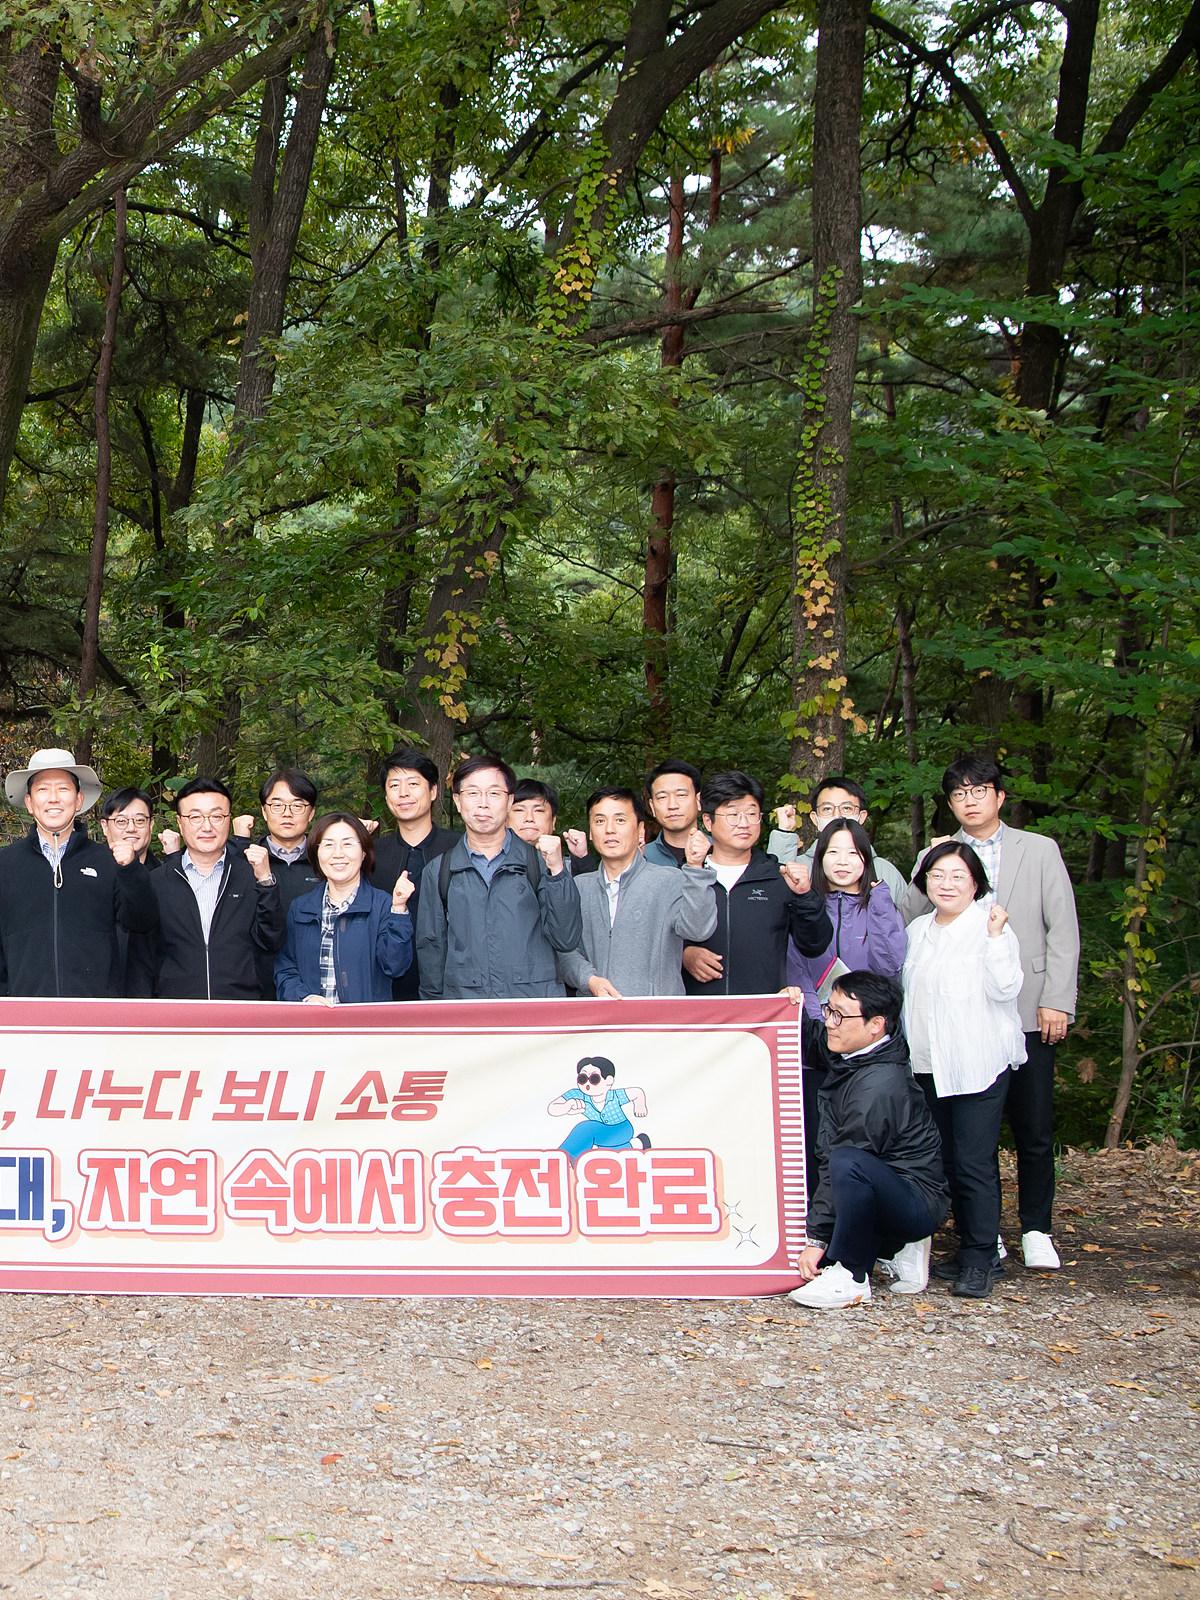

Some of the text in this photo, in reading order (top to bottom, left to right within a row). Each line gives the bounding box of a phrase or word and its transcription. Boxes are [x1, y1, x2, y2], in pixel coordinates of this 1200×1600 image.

[35, 1069, 203, 1121] 나누다
[212, 1070, 325, 1121] 보니
[335, 1070, 449, 1121] 소통
[86, 1157, 208, 1226] 자연
[230, 1157, 416, 1227] 속에서
[438, 1155, 562, 1228] 충전
[583, 1157, 713, 1228] 완료
